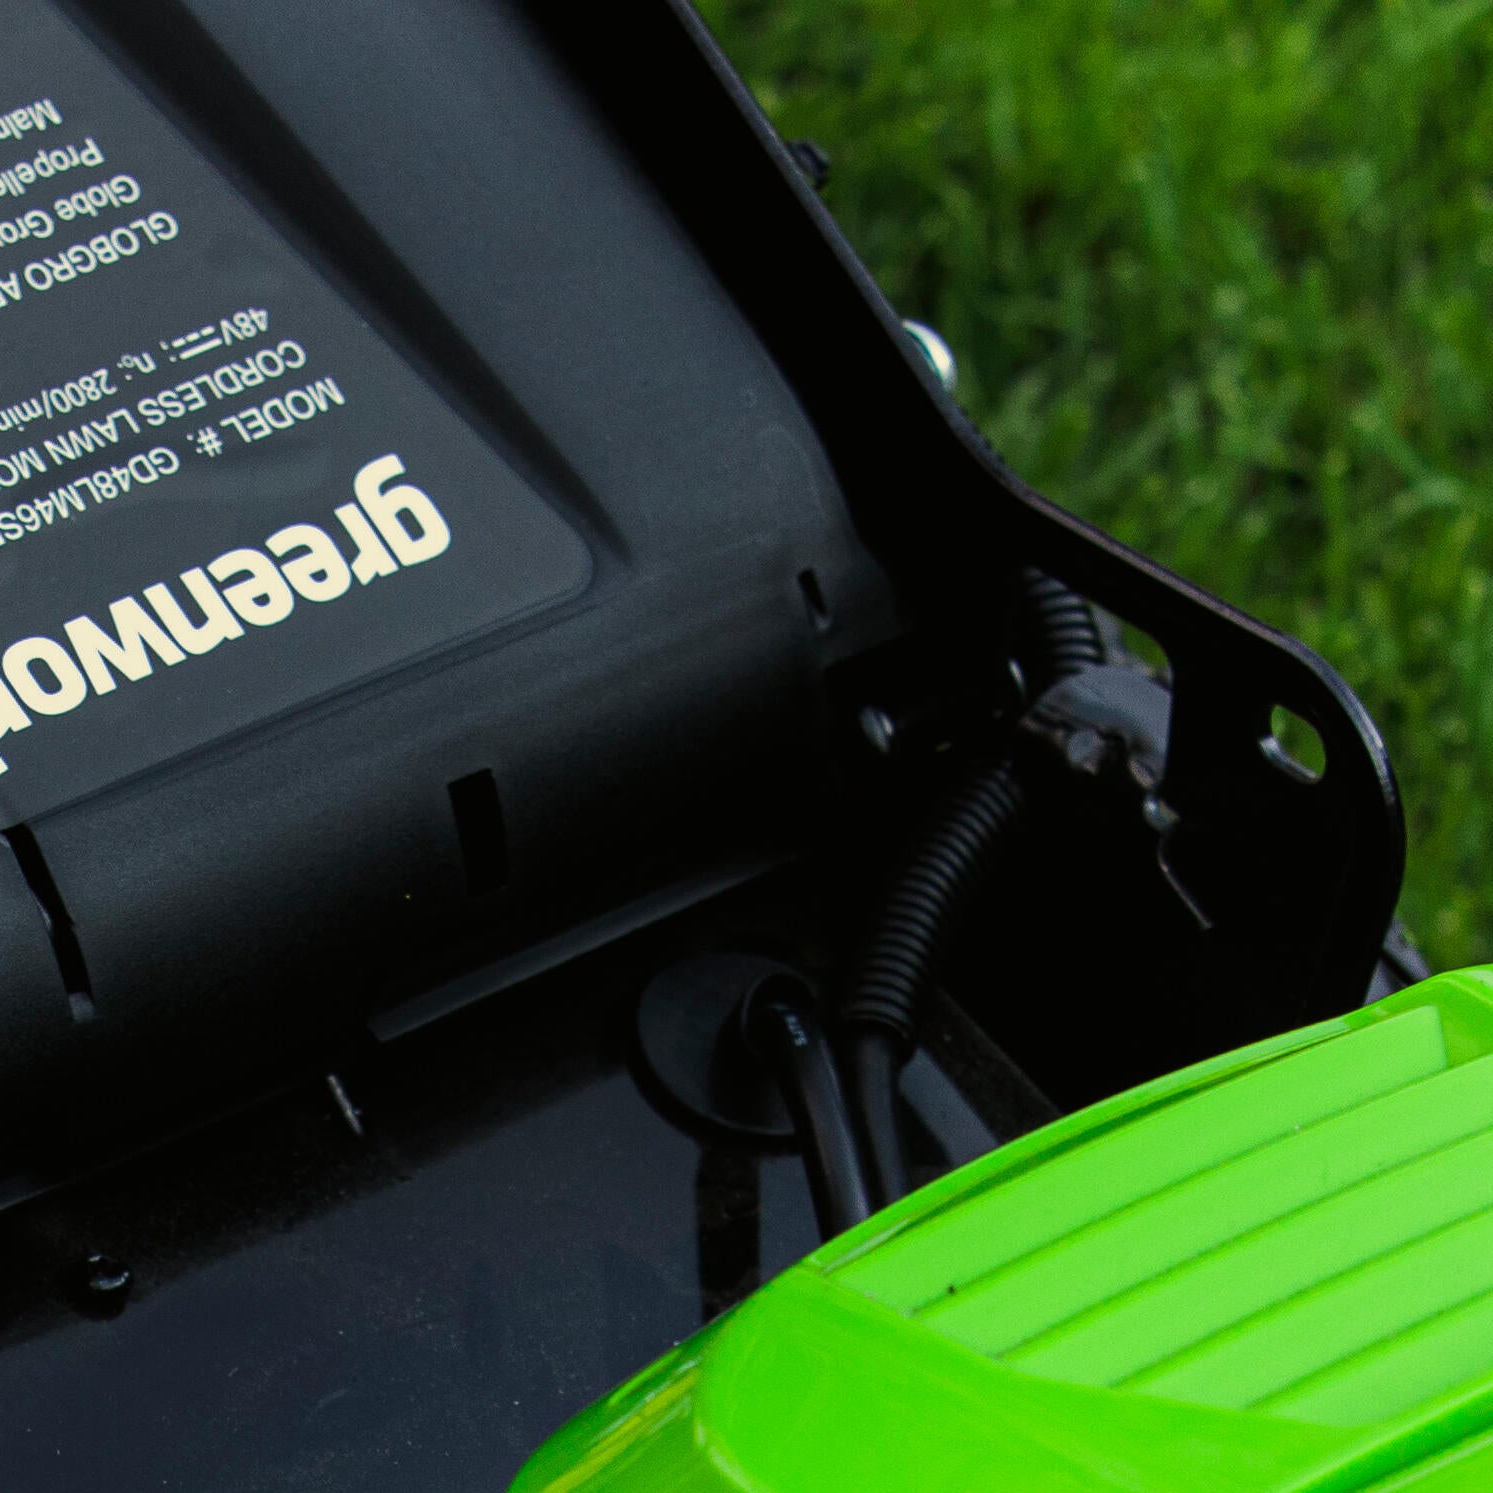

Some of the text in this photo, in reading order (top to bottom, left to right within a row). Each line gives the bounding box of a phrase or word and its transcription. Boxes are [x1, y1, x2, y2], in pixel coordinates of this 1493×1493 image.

[53, 173, 141, 222] Globe
[24, 210, 179, 291] GLOBGRO
[137, 339, 306, 426] CORDLESS
[220, 376, 346, 443] MODEL
[43, 408, 141, 465] LAWN
